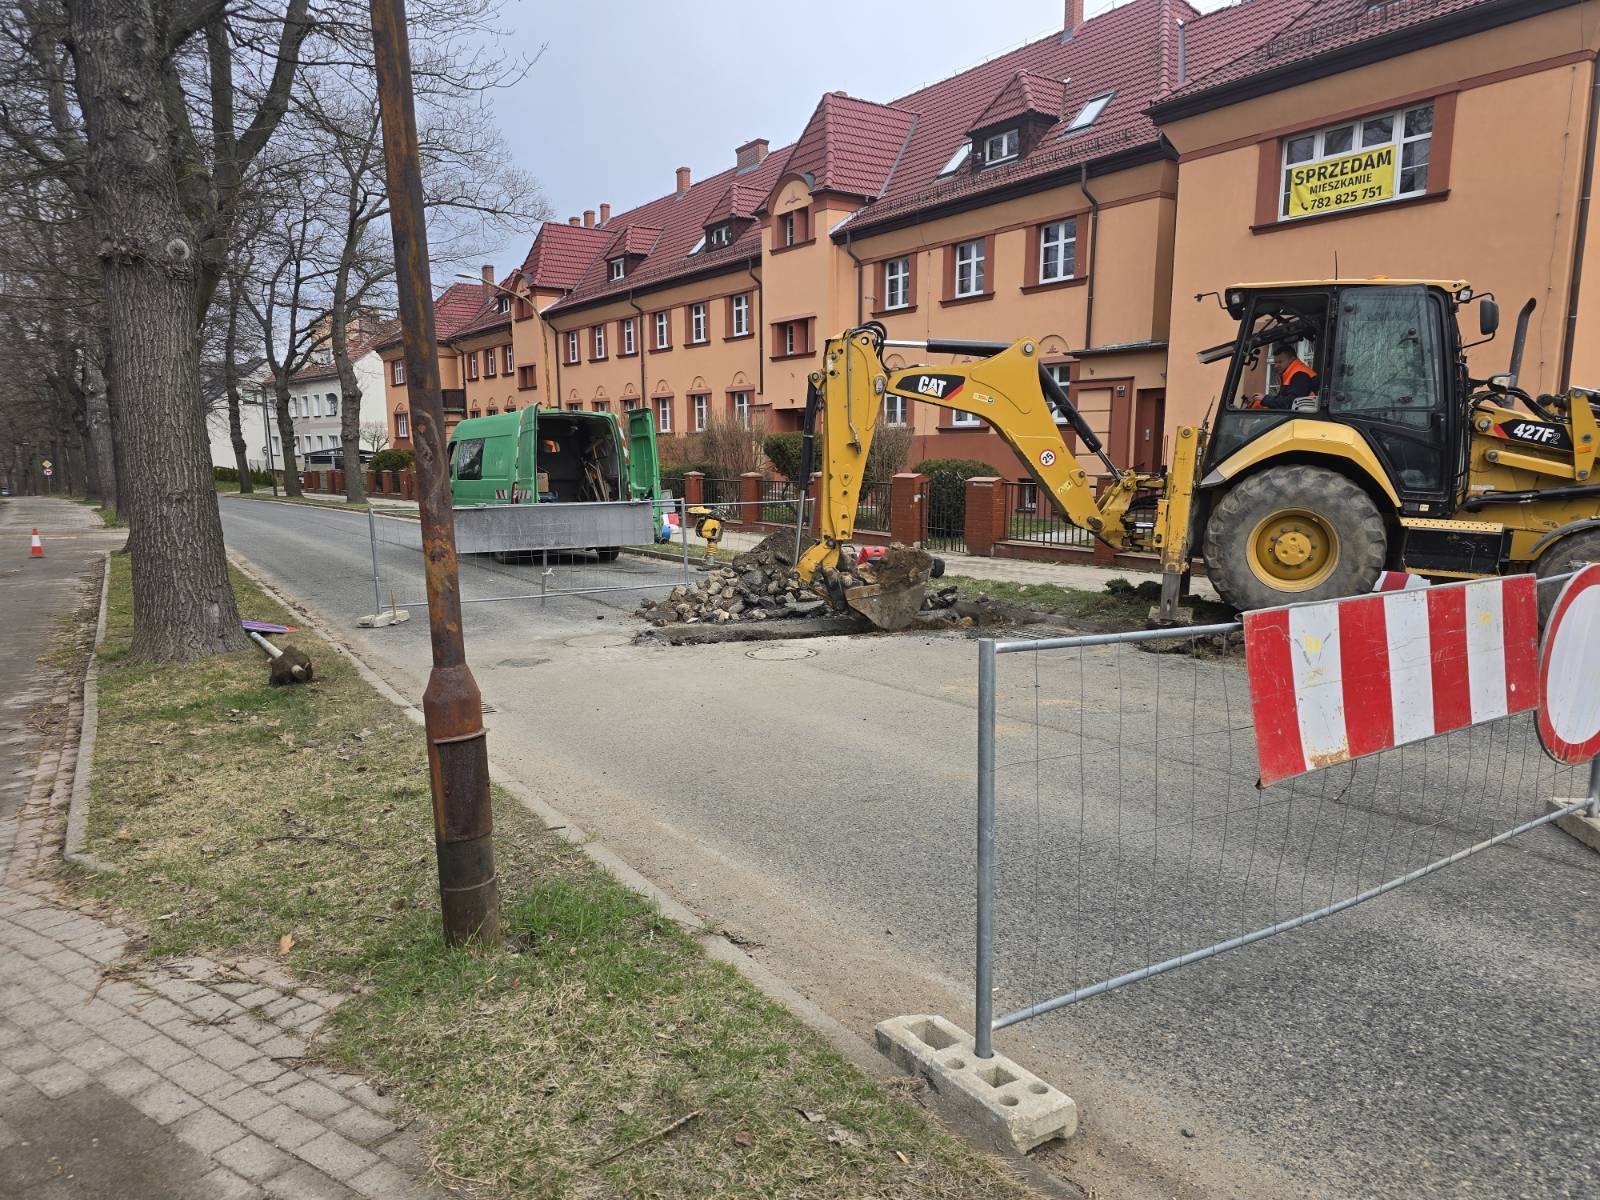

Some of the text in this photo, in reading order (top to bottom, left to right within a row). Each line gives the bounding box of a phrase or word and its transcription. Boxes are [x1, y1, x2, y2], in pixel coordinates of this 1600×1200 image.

[1294, 149, 1392, 186] SPRZEDAM
[1309, 173, 1373, 195] MIESZKANIE
[1310, 185, 1383, 210] 782 825 751
[917, 375, 947, 398] CAT
[1042, 452, 1054, 464] 25
